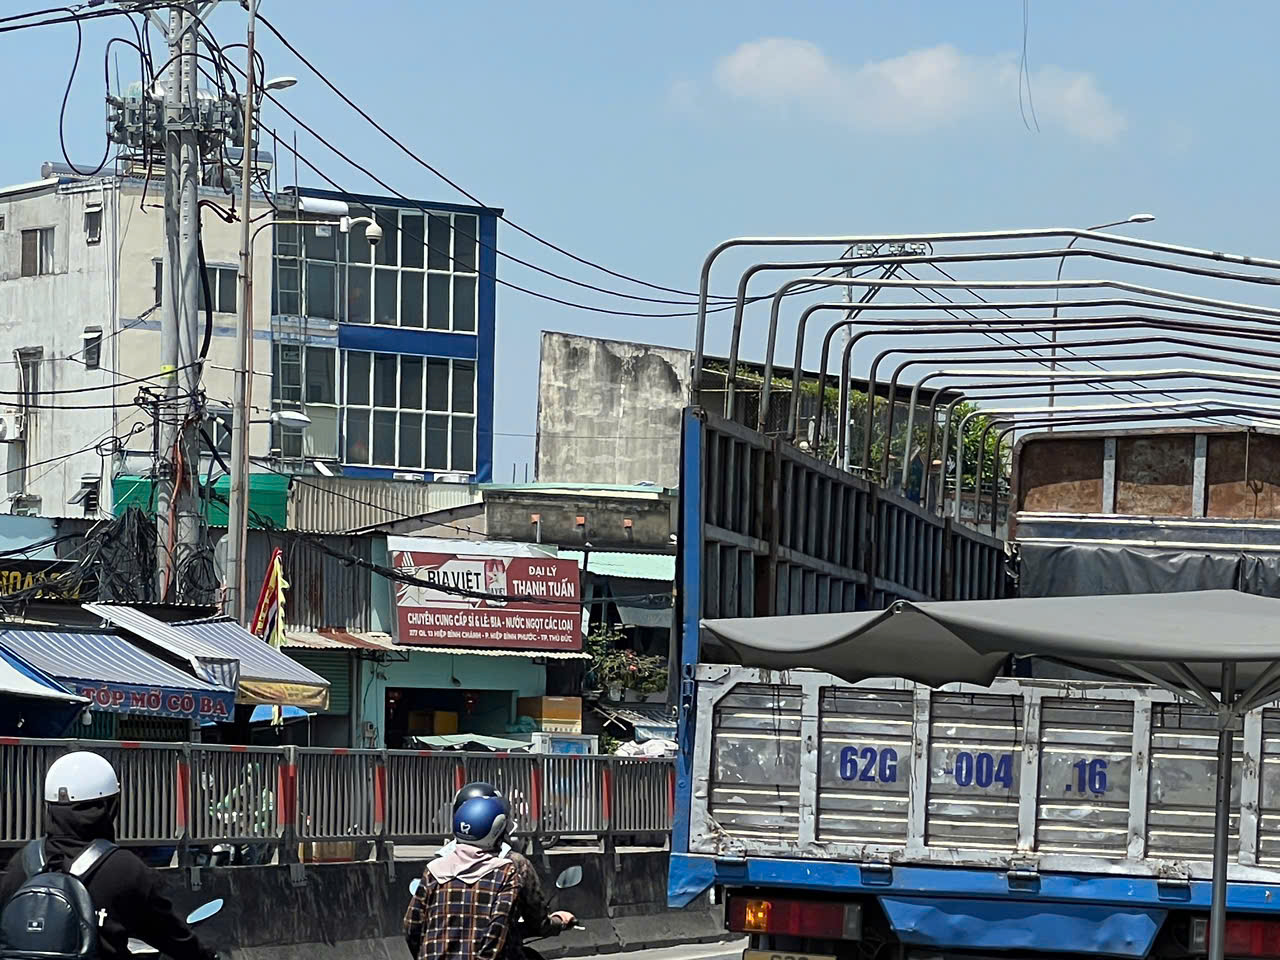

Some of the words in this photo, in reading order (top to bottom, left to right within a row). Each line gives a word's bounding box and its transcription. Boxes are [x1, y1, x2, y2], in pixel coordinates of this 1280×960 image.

[528, 566, 545, 578] ĐẠI
[547, 565, 557, 577] LÝ
[512, 580, 546, 596] THANH
[548, 578, 575, 598] TUẤN
[407, 611, 434, 626] CHUYÊN
[434, 613, 454, 627] CUNG
[544, 616, 557, 630] CÁC
[200, 696, 228, 719] BA
[839, 746, 898, 783] 62G
